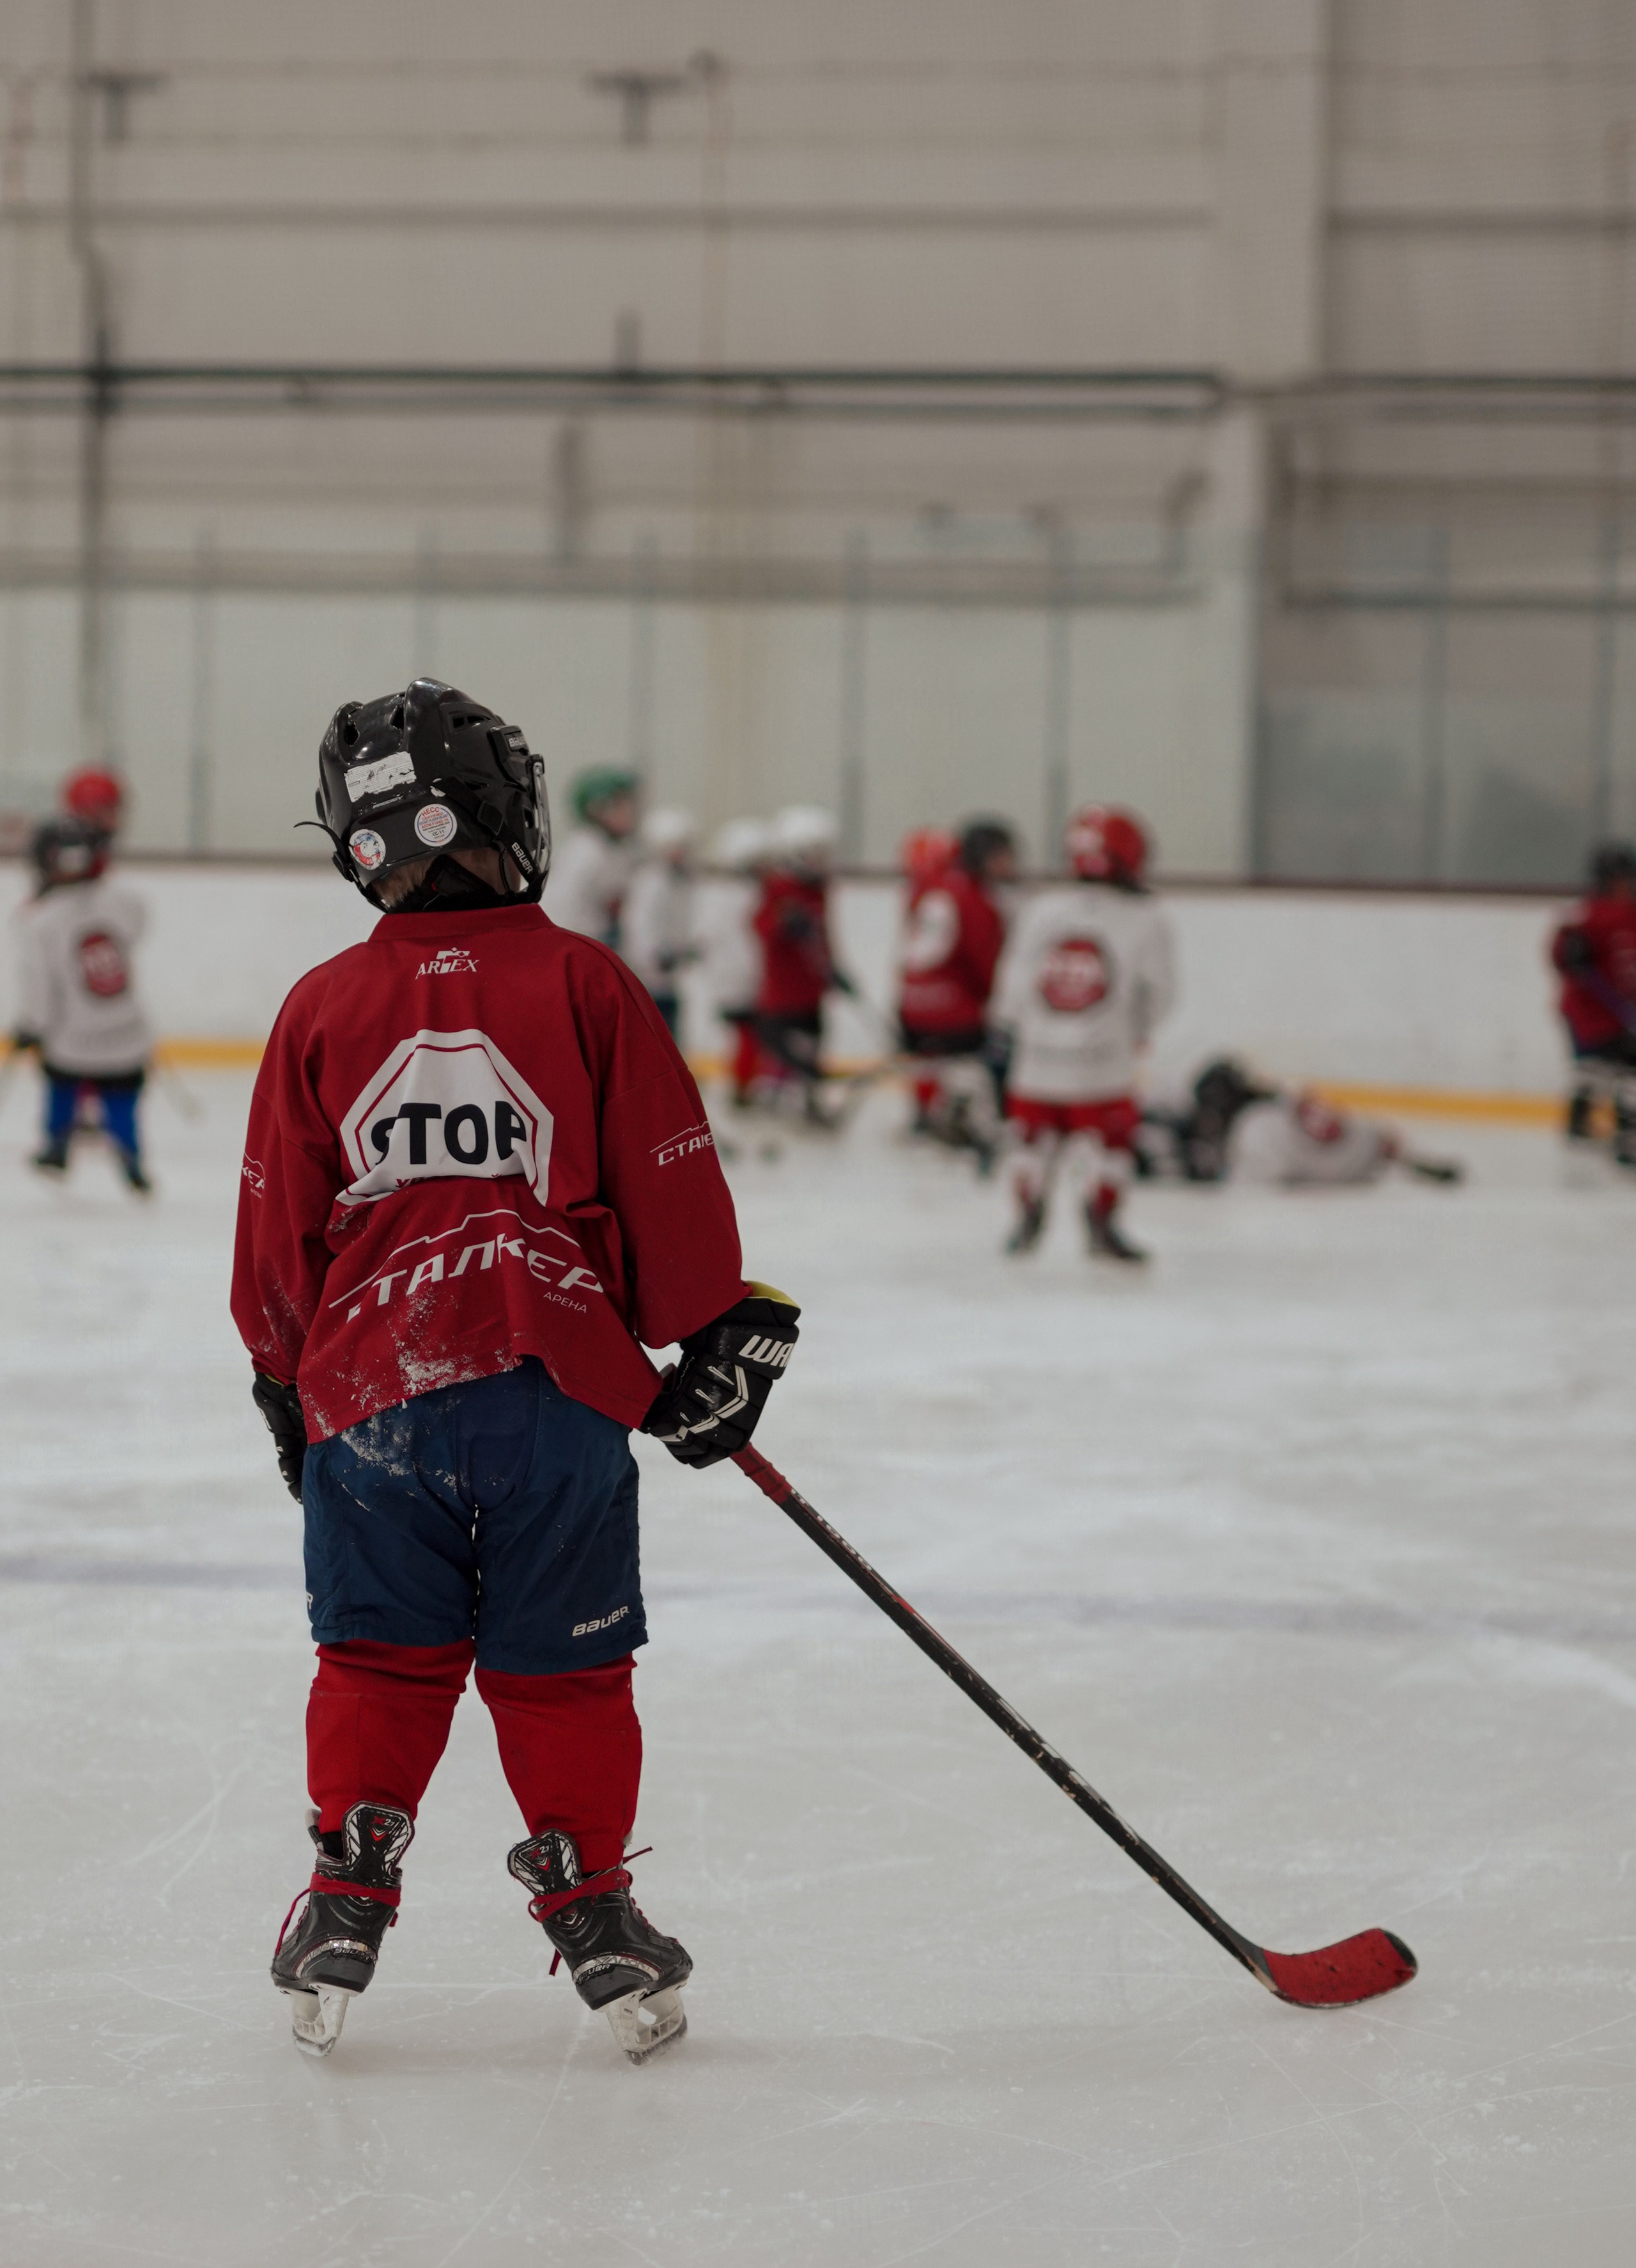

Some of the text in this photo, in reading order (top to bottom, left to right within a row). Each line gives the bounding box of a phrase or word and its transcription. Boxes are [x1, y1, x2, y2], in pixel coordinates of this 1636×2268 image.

[421, 807, 440, 817] HECC
[422, 812, 444, 821] CERTIFIED
[511, 842, 533, 874] BAUER
[347, 1233, 604, 1323] ТАЛКЕР
[543, 1291, 587, 1314] АРЕНА
[572, 1606, 631, 1636] BAUER
